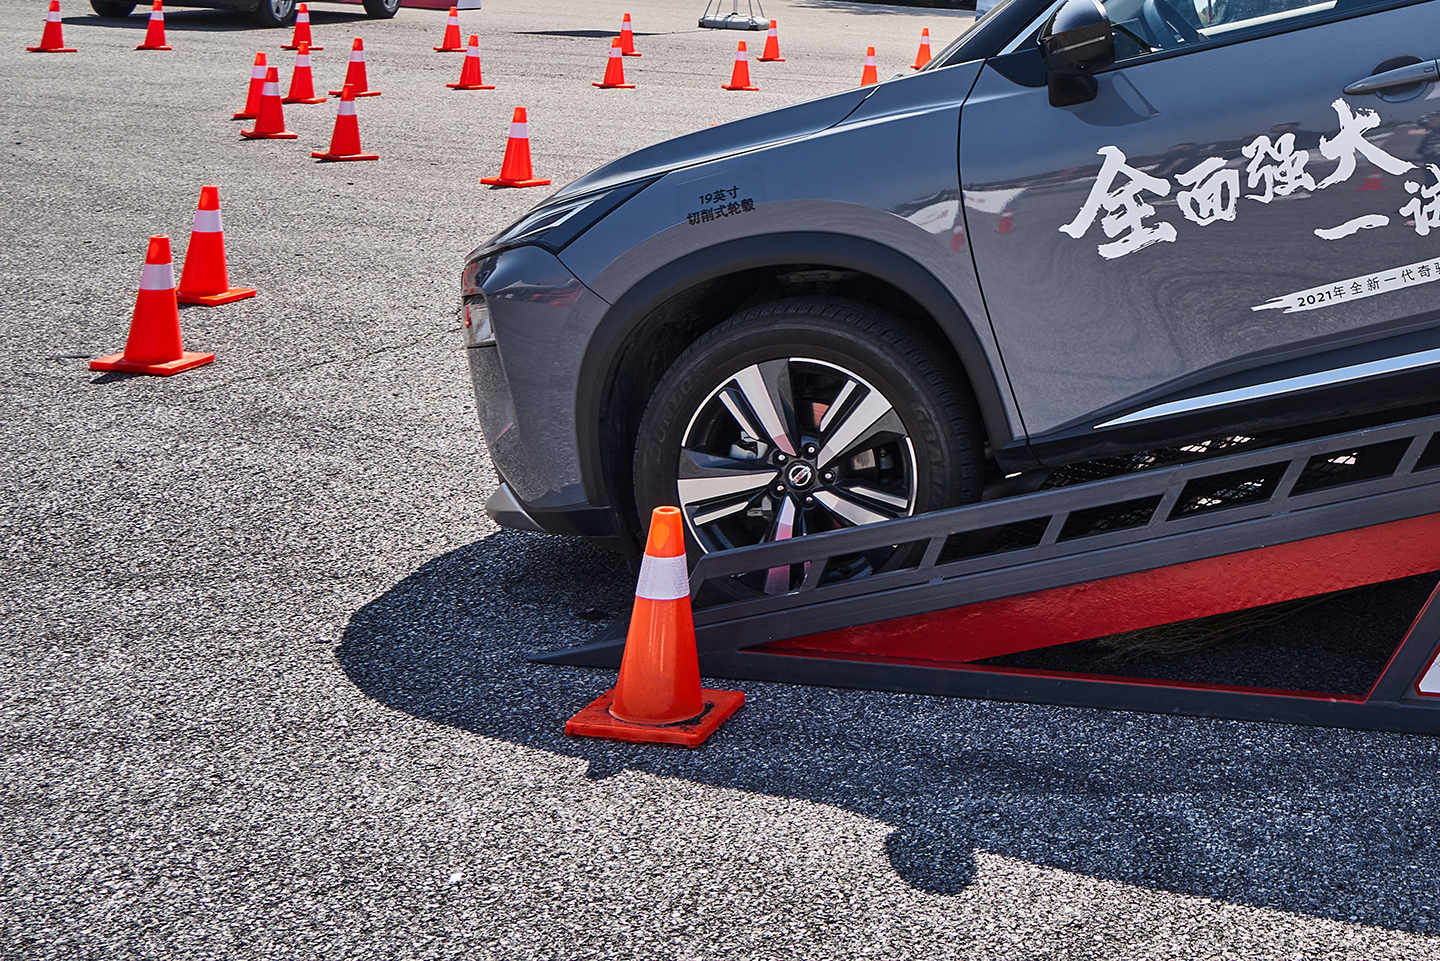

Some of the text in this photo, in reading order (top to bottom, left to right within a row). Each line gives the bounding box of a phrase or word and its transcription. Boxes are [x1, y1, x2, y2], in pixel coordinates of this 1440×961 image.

[1058, 97, 1421, 261] 全面强大
[699, 185, 740, 205] 19英寸
[687, 197, 756, 226] 切削式轮毂
